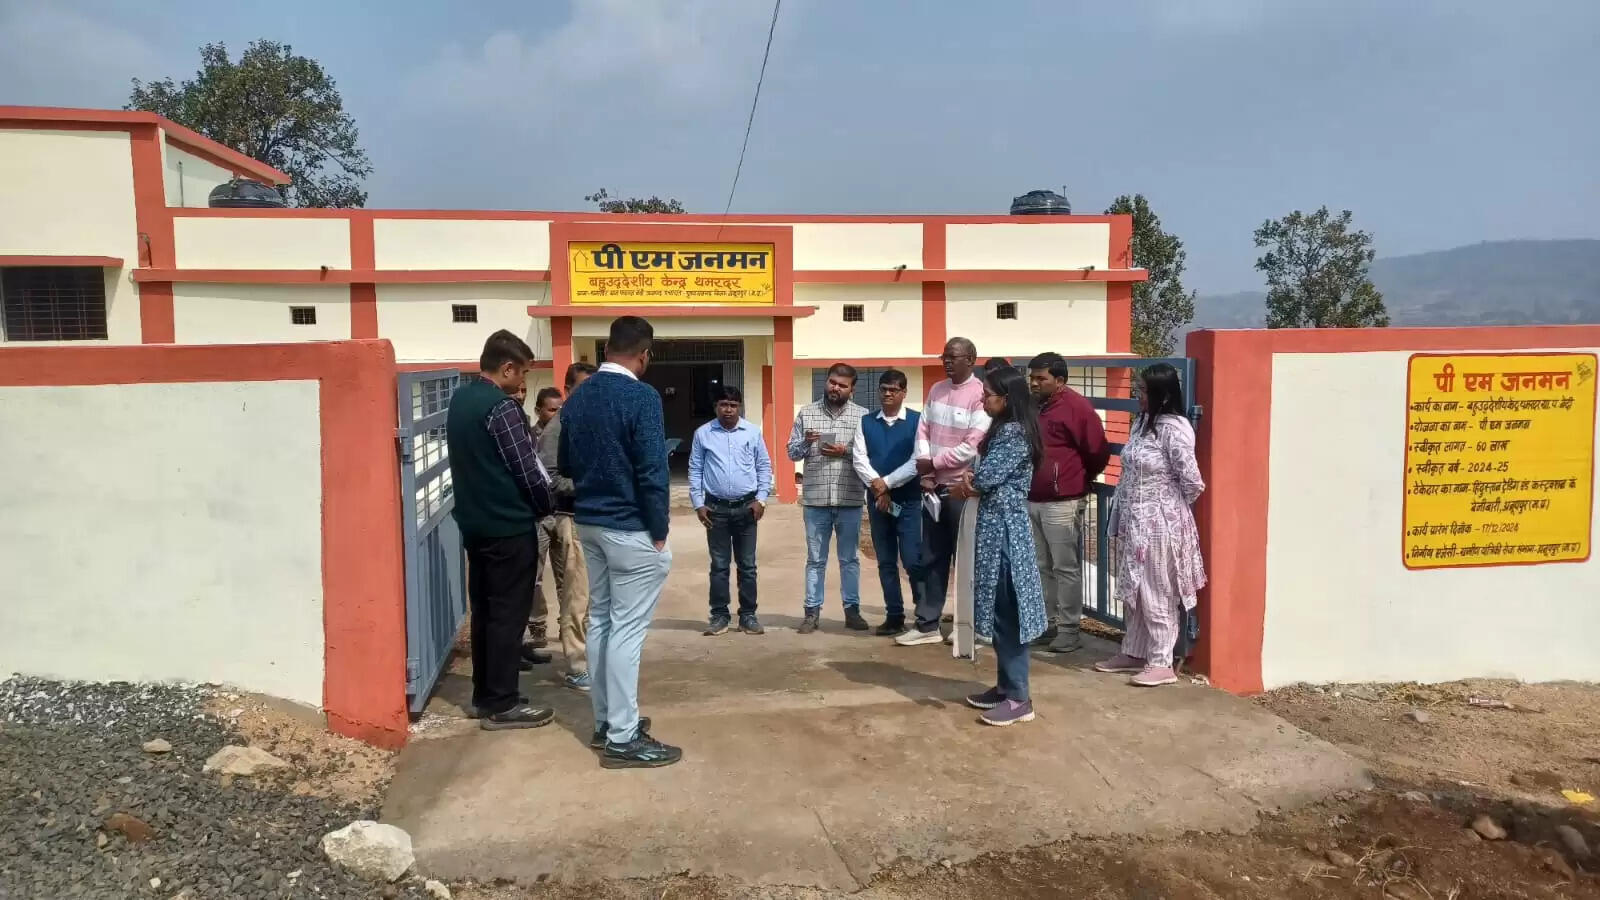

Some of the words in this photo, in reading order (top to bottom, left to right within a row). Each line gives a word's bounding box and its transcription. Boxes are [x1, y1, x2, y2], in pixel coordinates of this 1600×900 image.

[590, 243, 627, 270] पी
[629, 251, 676, 270] एम
[677, 251, 770, 271] जनमन
[694, 277, 742, 290] थमरदर
[1433, 363, 1456, 393] पी
[1463, 372, 1496, 393] एम
[1500, 371, 1573, 393] जनमन
[1413, 398, 1432, 413] कार्य
[1433, 402, 1443, 412] का
[1413, 417, 1438, 433] योजना
[1440, 422, 1451, 432] का
[1479, 416, 1489, 431] पी
[1489, 421, 1502, 431] एम
[1504, 419, 1532, 431] जनमन
[1413, 438, 1442, 456] स्वीकृत
[1443, 441, 1467, 453] लागत
[1476, 442, 1487, 452] 60
[1489, 439, 1511, 452] लाख
[1415, 459, 1446, 476] स्वीकृत
[1467, 461, 1510, 473] 2024-25
[1440, 483, 1452, 494] का
[1412, 521, 1429, 537] कार्य
[1430, 523, 1448, 536] प्रारंभ
[1481, 522, 1520, 534] 17/12/2024
[1411, 544, 1434, 559] निर्माण
